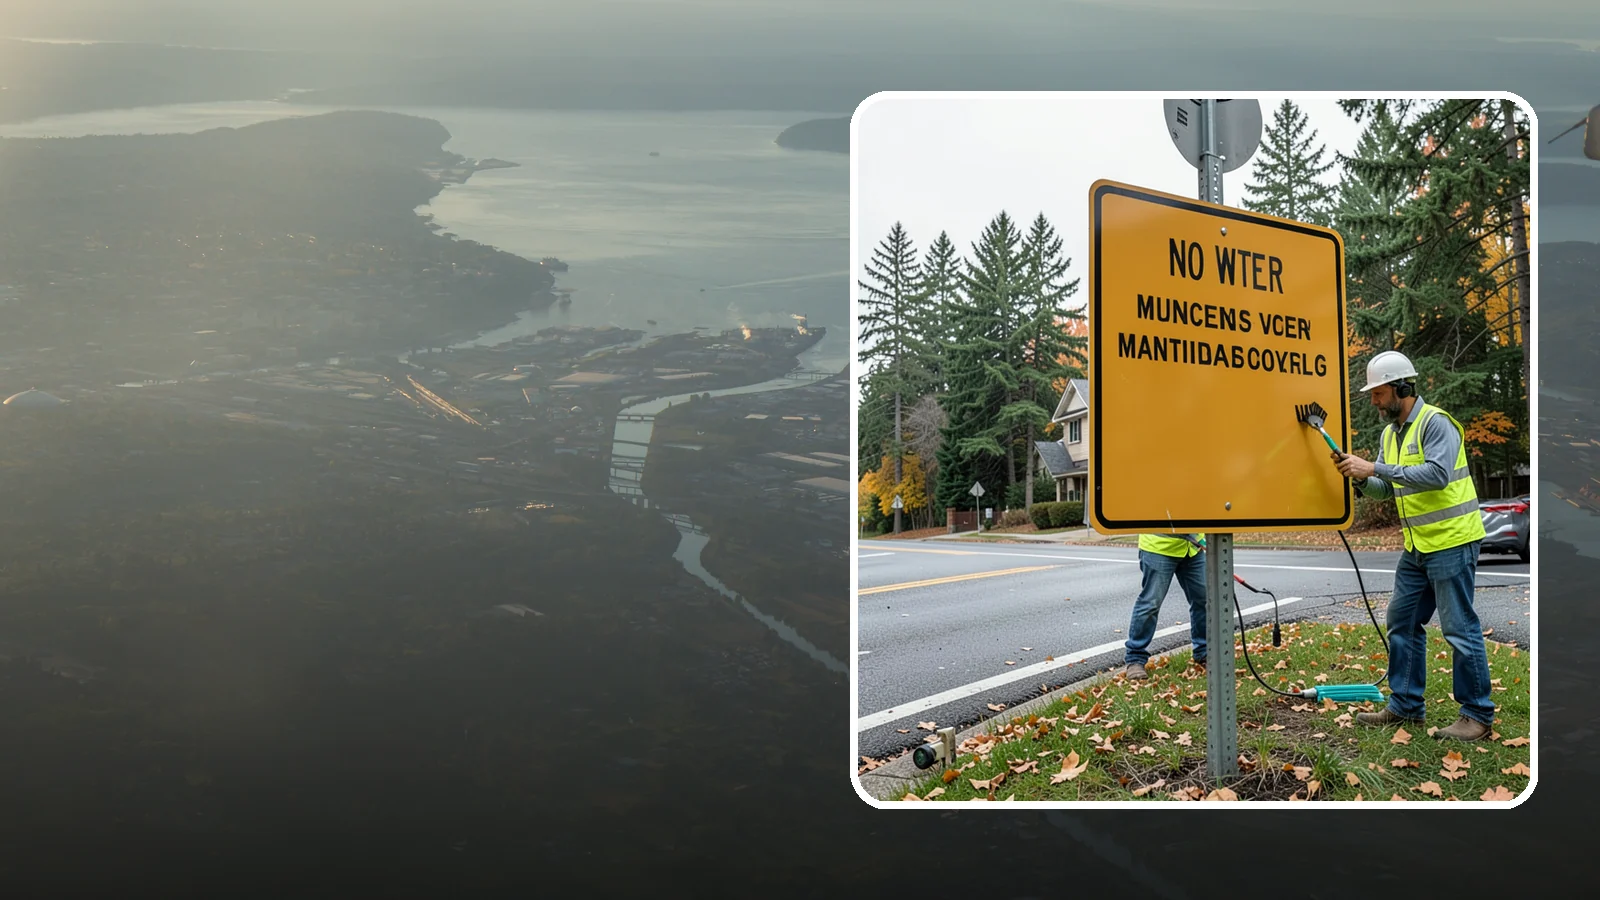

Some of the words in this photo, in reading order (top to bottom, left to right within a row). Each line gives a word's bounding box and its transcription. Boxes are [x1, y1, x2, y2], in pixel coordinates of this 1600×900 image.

[1169, 237, 1204, 281] NO
[1214, 245, 1284, 295] WTER
[1137, 293, 1252, 333] MUNCENS
